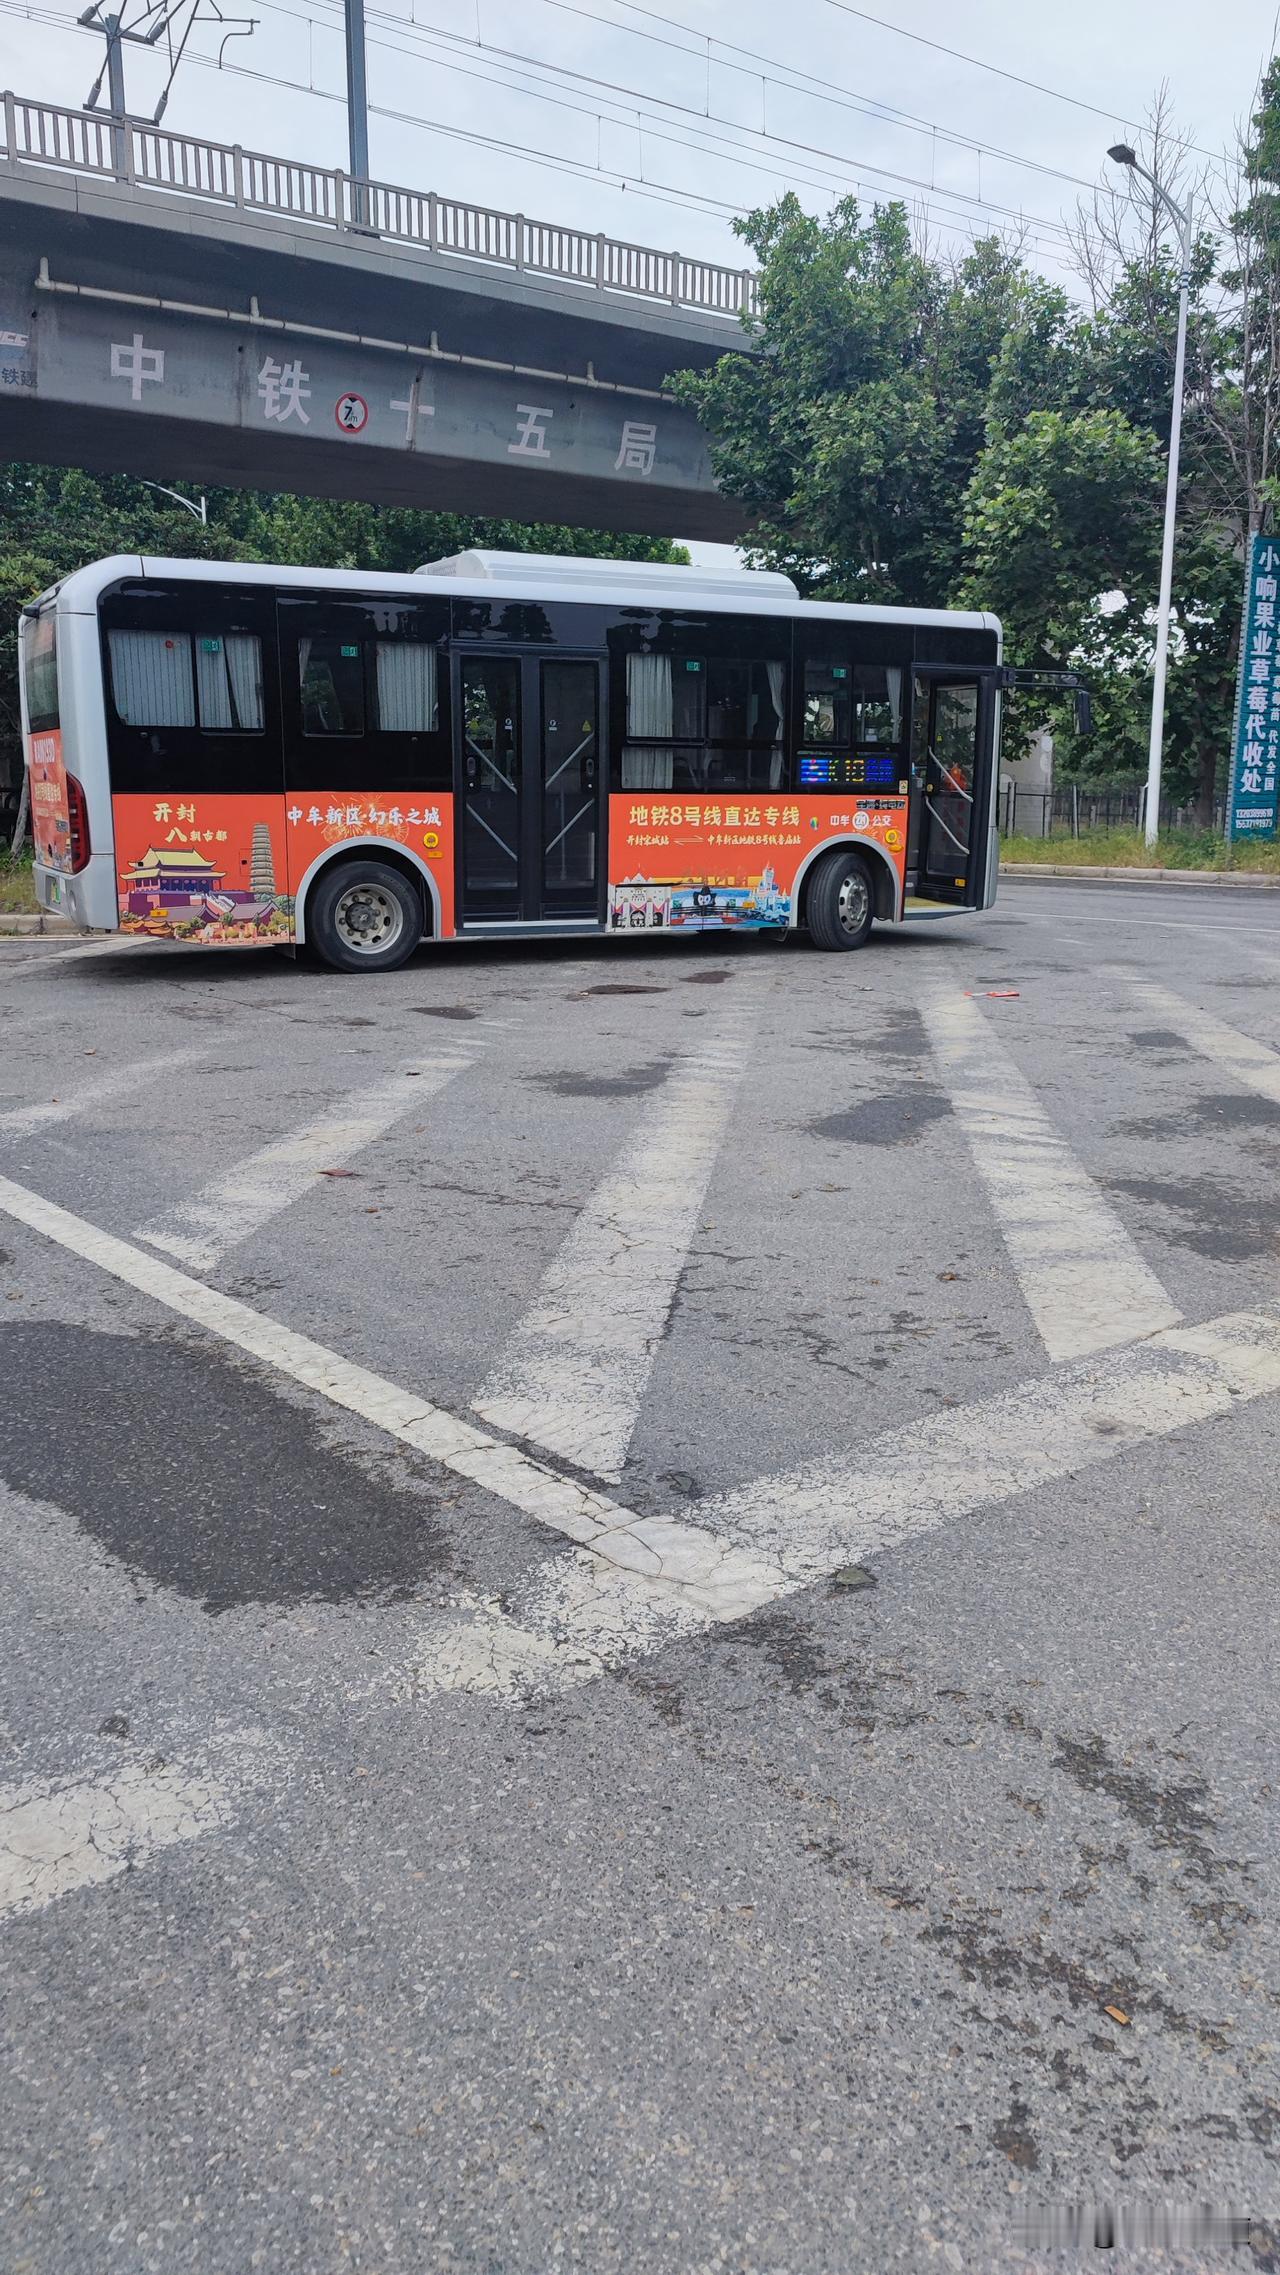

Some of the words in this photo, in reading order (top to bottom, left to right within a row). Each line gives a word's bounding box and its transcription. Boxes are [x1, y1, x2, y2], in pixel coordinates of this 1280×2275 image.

[111, 334, 657, 476] 中铁十五局
[1240, 546, 1280, 793] 小响果业草莓代收处
[153, 802, 196, 824] 开封
[629, 805, 800, 827] 地铁8号线直达专线
